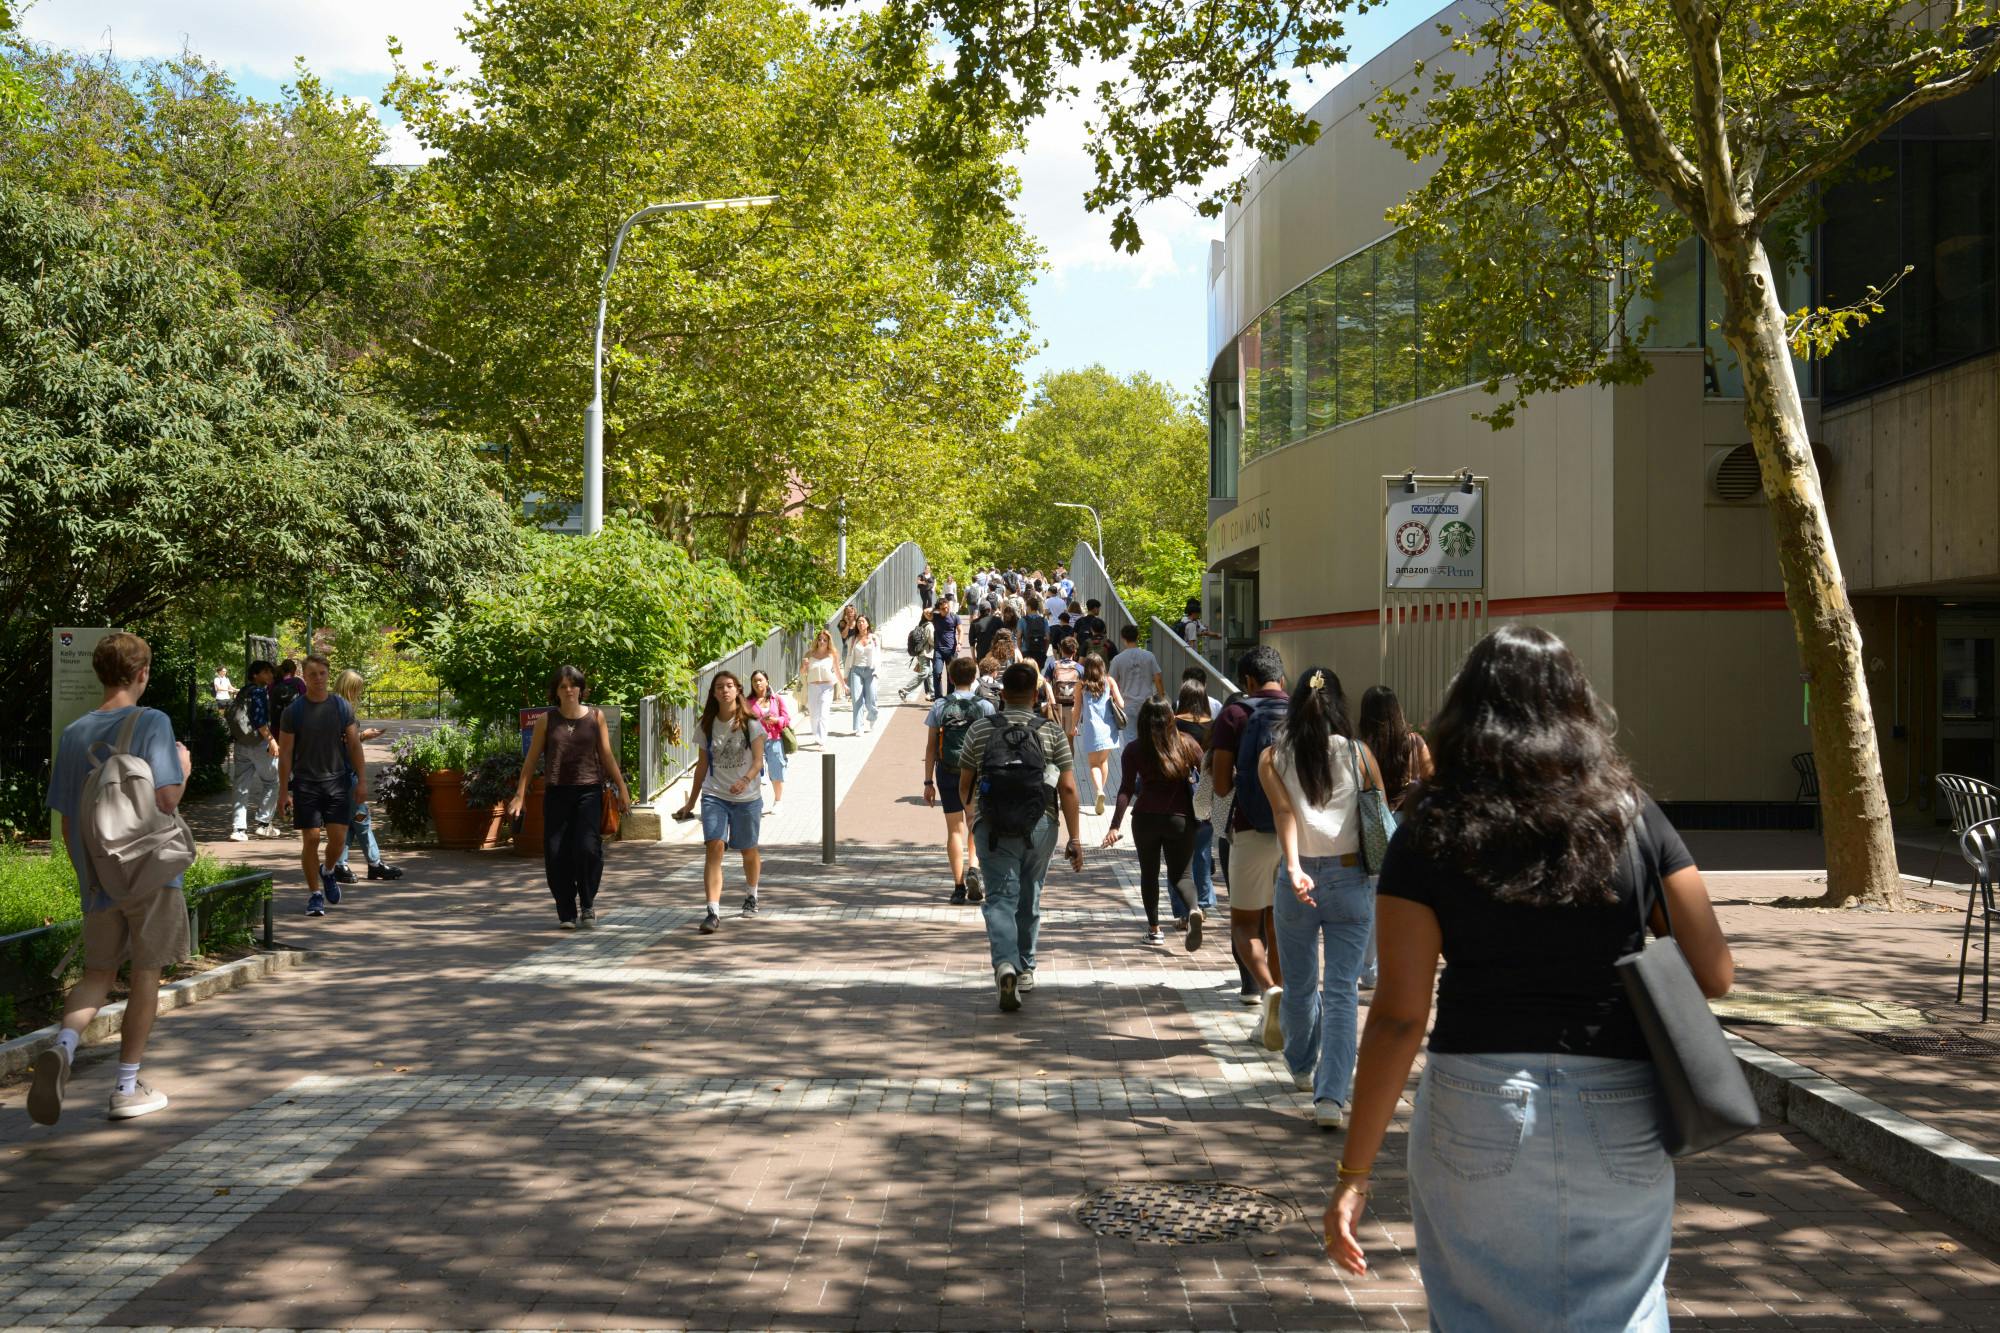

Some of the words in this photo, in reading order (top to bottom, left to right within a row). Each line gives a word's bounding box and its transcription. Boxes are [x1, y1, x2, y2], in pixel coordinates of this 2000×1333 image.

[1412, 505, 1458, 513] COMMONS
[1230, 507, 1271, 543] COMMONS
[1447, 565, 1474, 577] Penn
